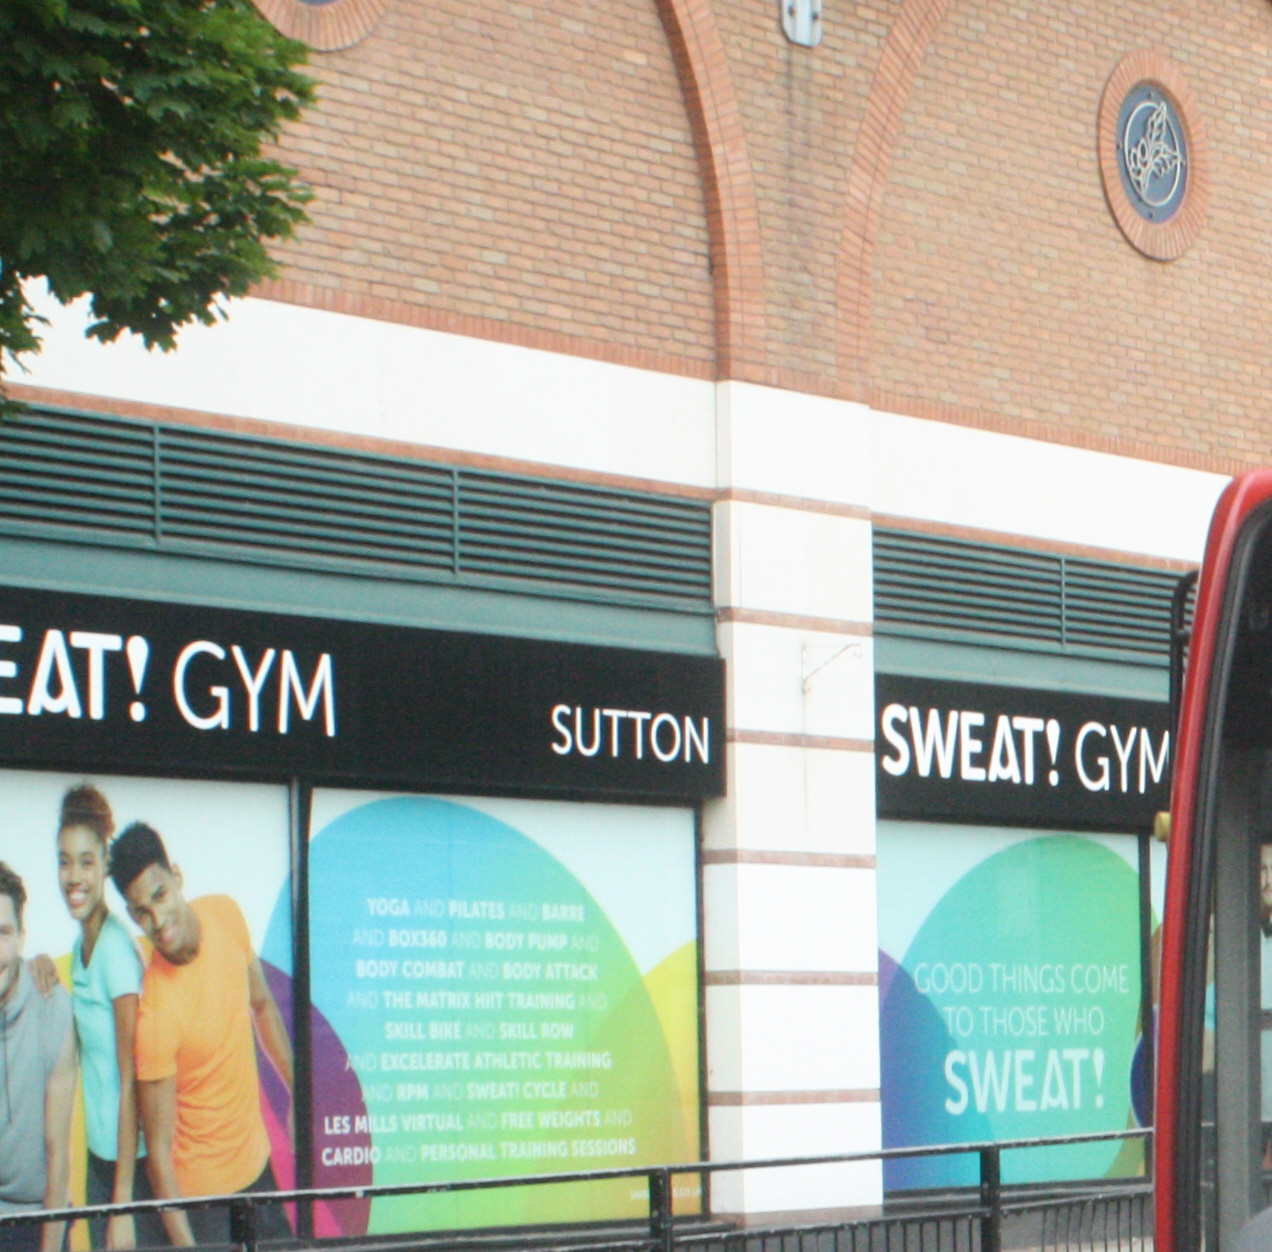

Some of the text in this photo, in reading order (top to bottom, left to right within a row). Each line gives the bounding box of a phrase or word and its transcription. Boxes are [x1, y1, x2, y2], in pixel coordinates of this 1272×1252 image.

[172, 640, 336, 738] GYM
[552, 703, 709, 764] SUTTON
[882, 703, 1169, 794] SWEAT! GYM
[367, 897, 410, 916] YOGA
[448, 900, 505, 920] PILATES
[541, 903, 585, 921] BARRE
[388, 929, 447, 948] BOX360
[484, 931, 525, 950] BODY
[528, 932, 568, 950] PUMP
[355, 959, 398, 978] BODY
[401, 959, 465, 979] COMBAT
[502, 961, 542, 980] BODY
[545, 963, 597, 981] ATTACK
[914, 962, 1129, 994] GOOD THINGS COME
[382, 990, 412, 1009] THE
[415, 991, 471, 1010] MATRIX
[474, 991, 503, 1009] HIIT
[507, 992, 576, 1010] TRAINING
[384, 1021, 426, 1040] SKILL
[428, 1021, 462, 1040] BIKE
[498, 1021, 538, 1040] SKILL
[540, 1021, 575, 1039] ROW
[943, 1006, 1104, 1037] TO THOSE WHO
[380, 1052, 470, 1071] EXCELERATE
[473, 1052, 542, 1070] ATHLETIC
[545, 1051, 613, 1069] TRAINING
[396, 1082, 429, 1101] RPM
[467, 1081, 520, 1099] SWEAT!
[523, 1081, 567, 1098] CYCLE
[944, 1048, 1105, 1116] SWEAT!
[324, 1115, 351, 1135] LES
[354, 1114, 398, 1133] MILLS
[401, 1113, 464, 1132] VIRTUAL
[501, 1110, 535, 1129] FREE
[538, 1110, 601, 1128] WEIGHTS
[321, 1146, 381, 1167] CARDIO
[420, 1142, 497, 1162] PERSONAL
[501, 1140, 568, 1158] TRAINING
[571, 1138, 636, 1157] SESSIONS
